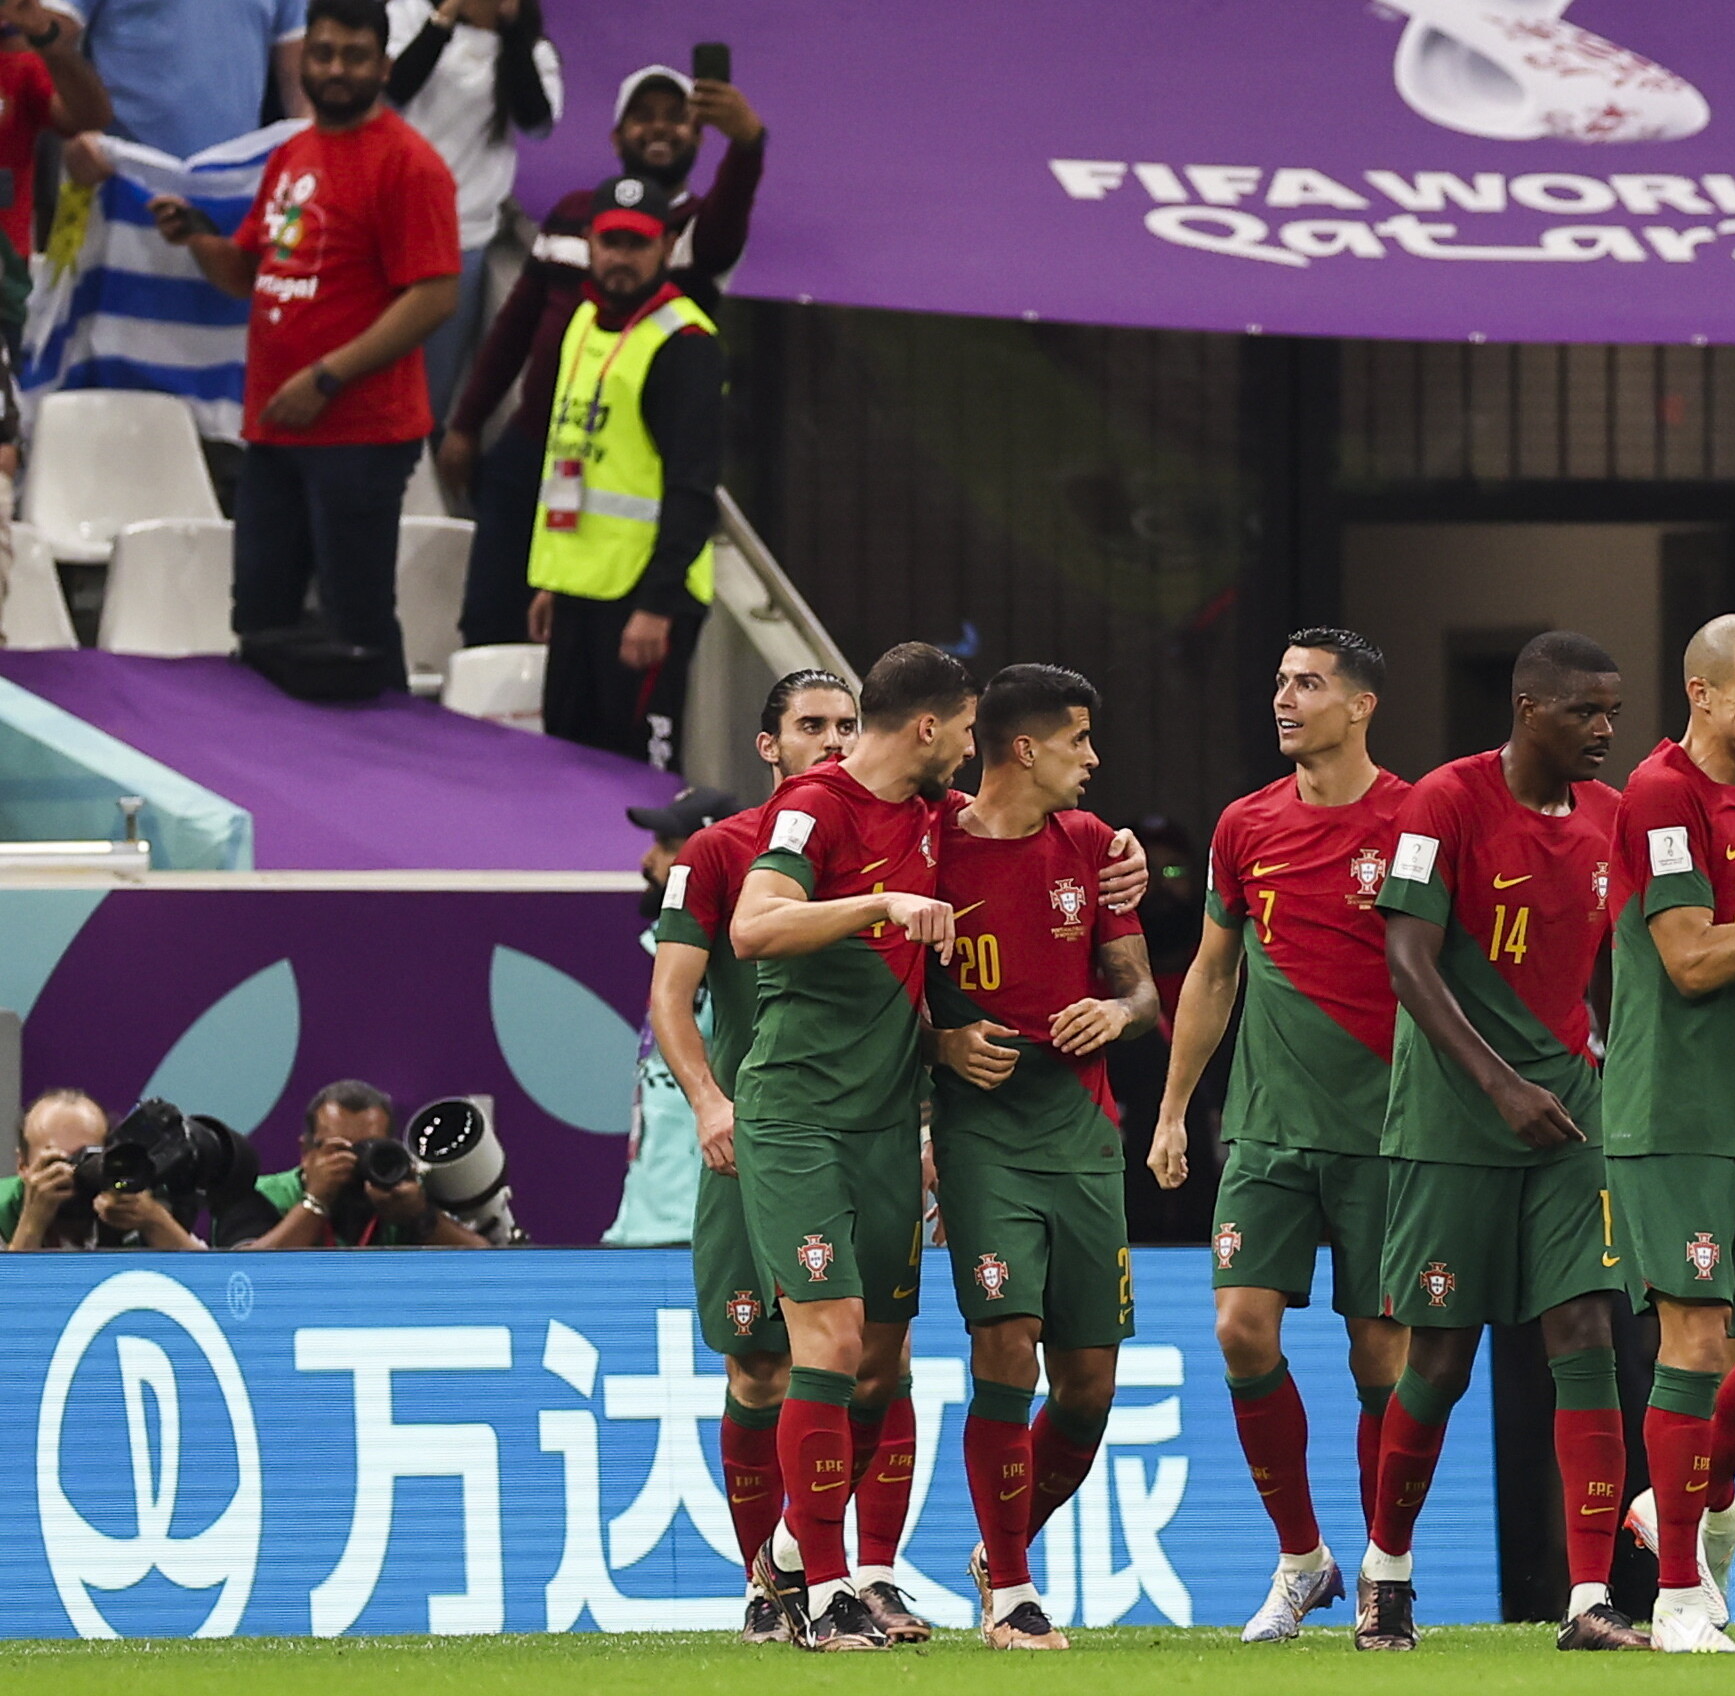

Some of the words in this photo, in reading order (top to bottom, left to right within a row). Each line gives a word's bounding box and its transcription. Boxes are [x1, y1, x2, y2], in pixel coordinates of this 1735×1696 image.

[1050, 159, 1368, 208] FIFA
[1258, 890, 1275, 944] 7
[1489, 904, 1529, 964] 14
[955, 933, 1001, 991] 20
